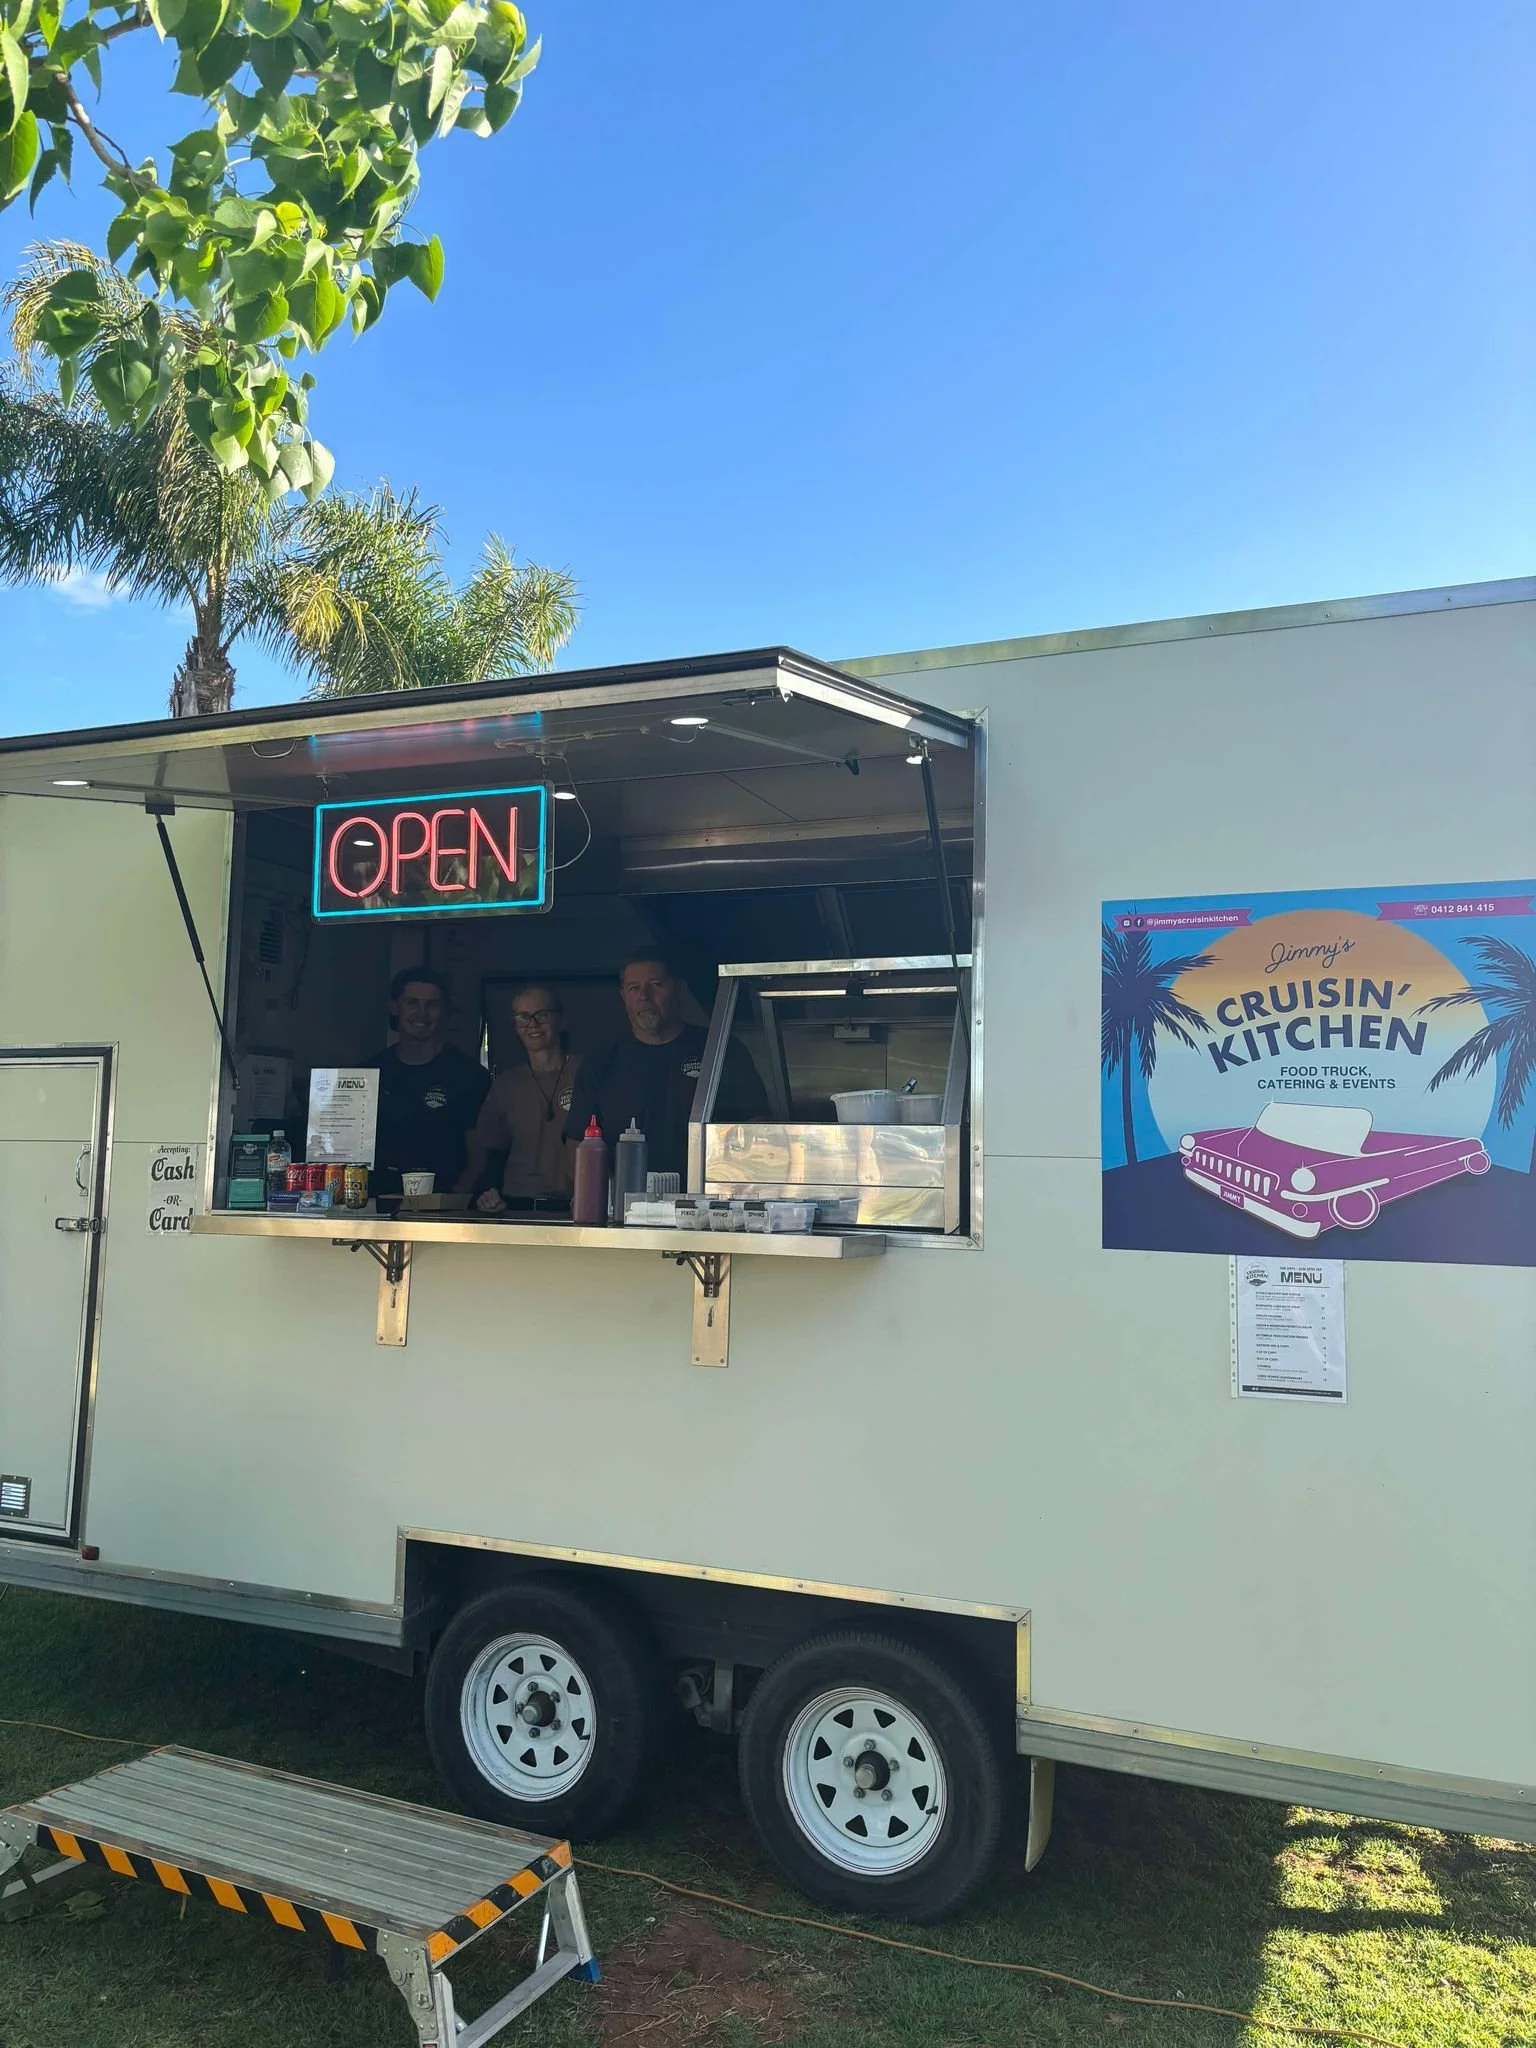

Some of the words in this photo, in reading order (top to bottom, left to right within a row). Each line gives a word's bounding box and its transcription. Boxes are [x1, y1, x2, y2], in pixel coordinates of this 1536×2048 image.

[329, 807, 518, 898] OPEN
[1431, 905, 1454, 914] 0412
[1456, 904, 1473, 913] 841
[1476, 903, 1494, 911] 415
[1147, 915, 1239, 926] @jimmyscruisinkitchen
[1264, 936, 1356, 974] Jimmy's
[1216, 978, 1412, 1027] CRUISIN'
[1207, 1014, 1428, 1074] KITCHEN
[1280, 1066, 1318, 1077] FOOD
[1321, 1066, 1372, 1078] TRUCK,
[337, 1080, 366, 1089] MENU
[1257, 1079, 1325, 1089] CATERING
[1329, 1079, 1339, 1089] &
[1342, 1079, 1396, 1089] EVENTS
[157, 1145, 191, 1154] Accepting:
[151, 1156, 194, 1181] Cash
[149, 1207, 193, 1231] Card
[1280, 1271, 1323, 1284] MENU
